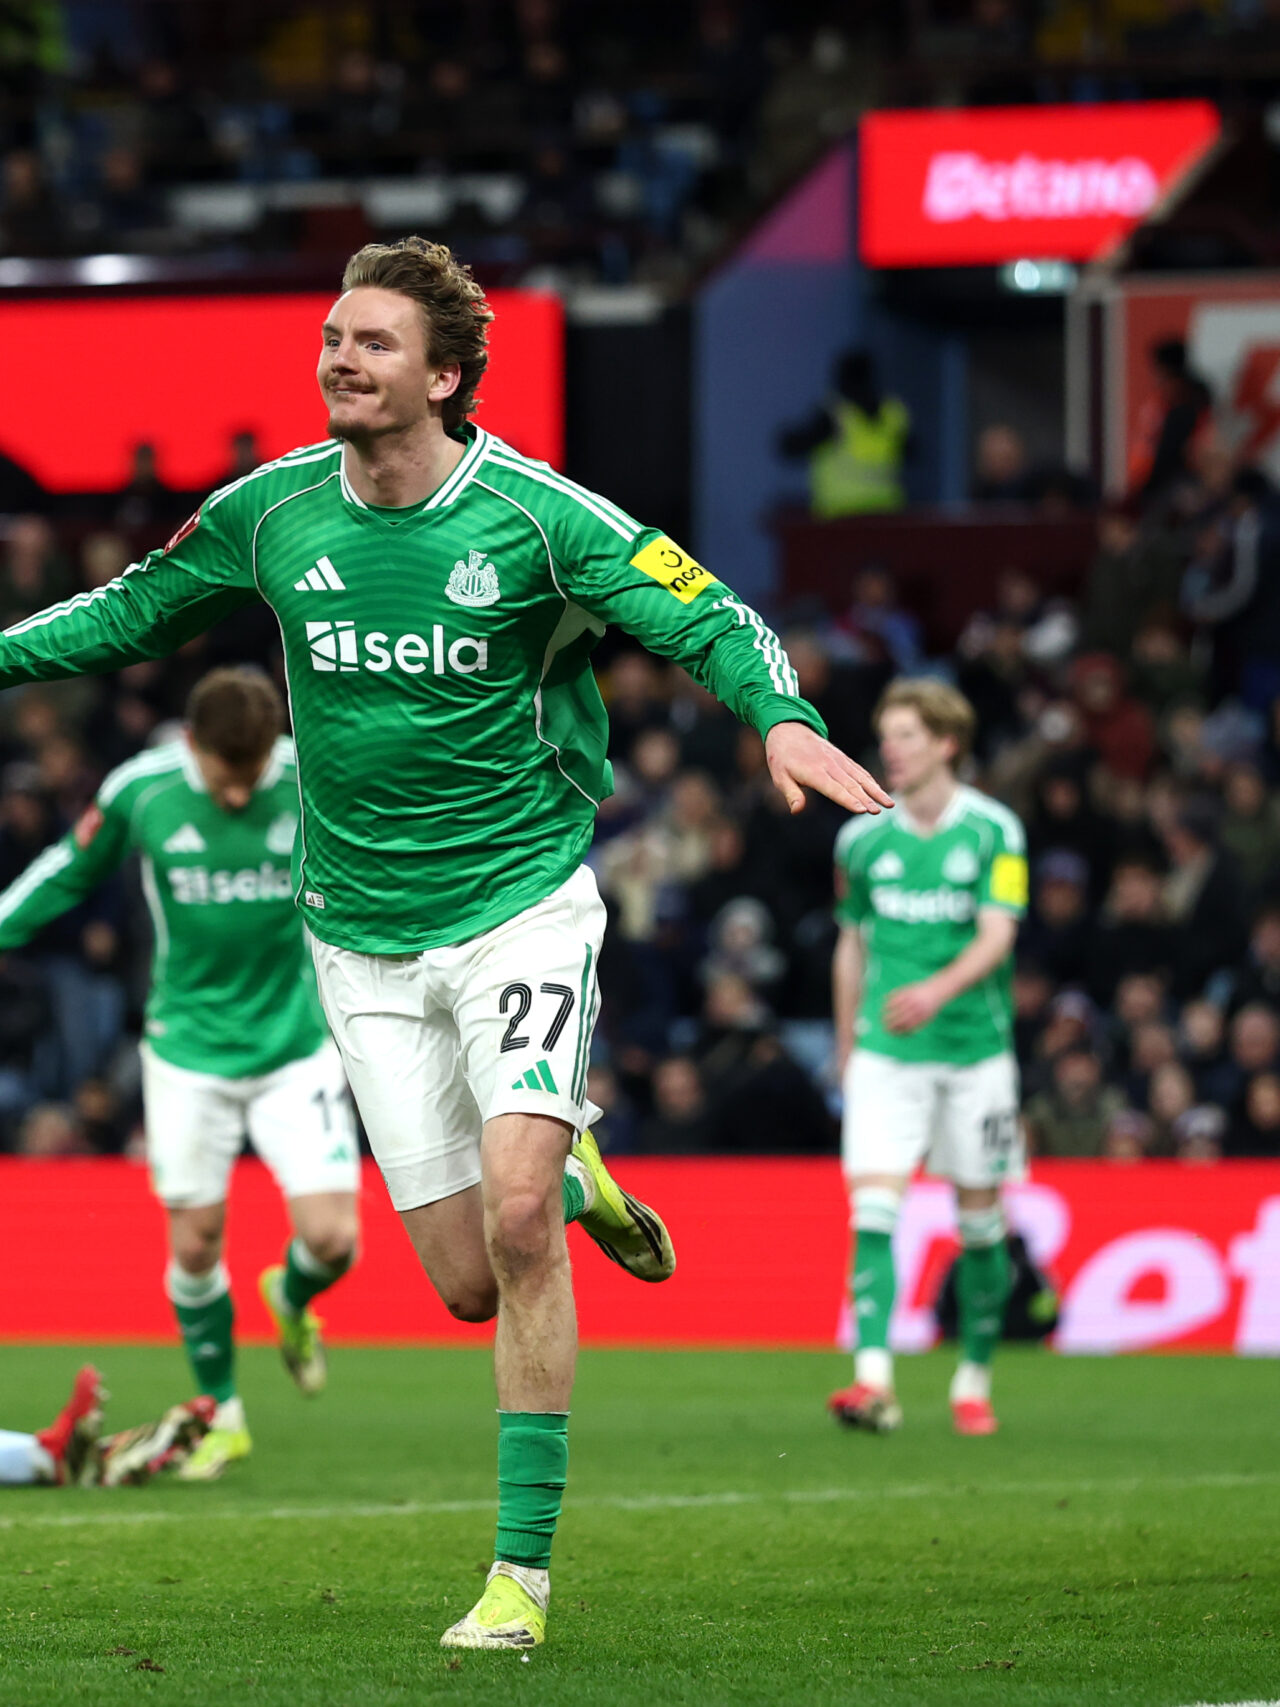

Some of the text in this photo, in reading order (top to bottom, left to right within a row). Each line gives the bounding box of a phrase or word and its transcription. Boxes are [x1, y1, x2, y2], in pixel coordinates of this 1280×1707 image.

[923, 151, 1159, 222] Betano
[364, 624, 489, 675] sela
[499, 982, 575, 1054] 27
